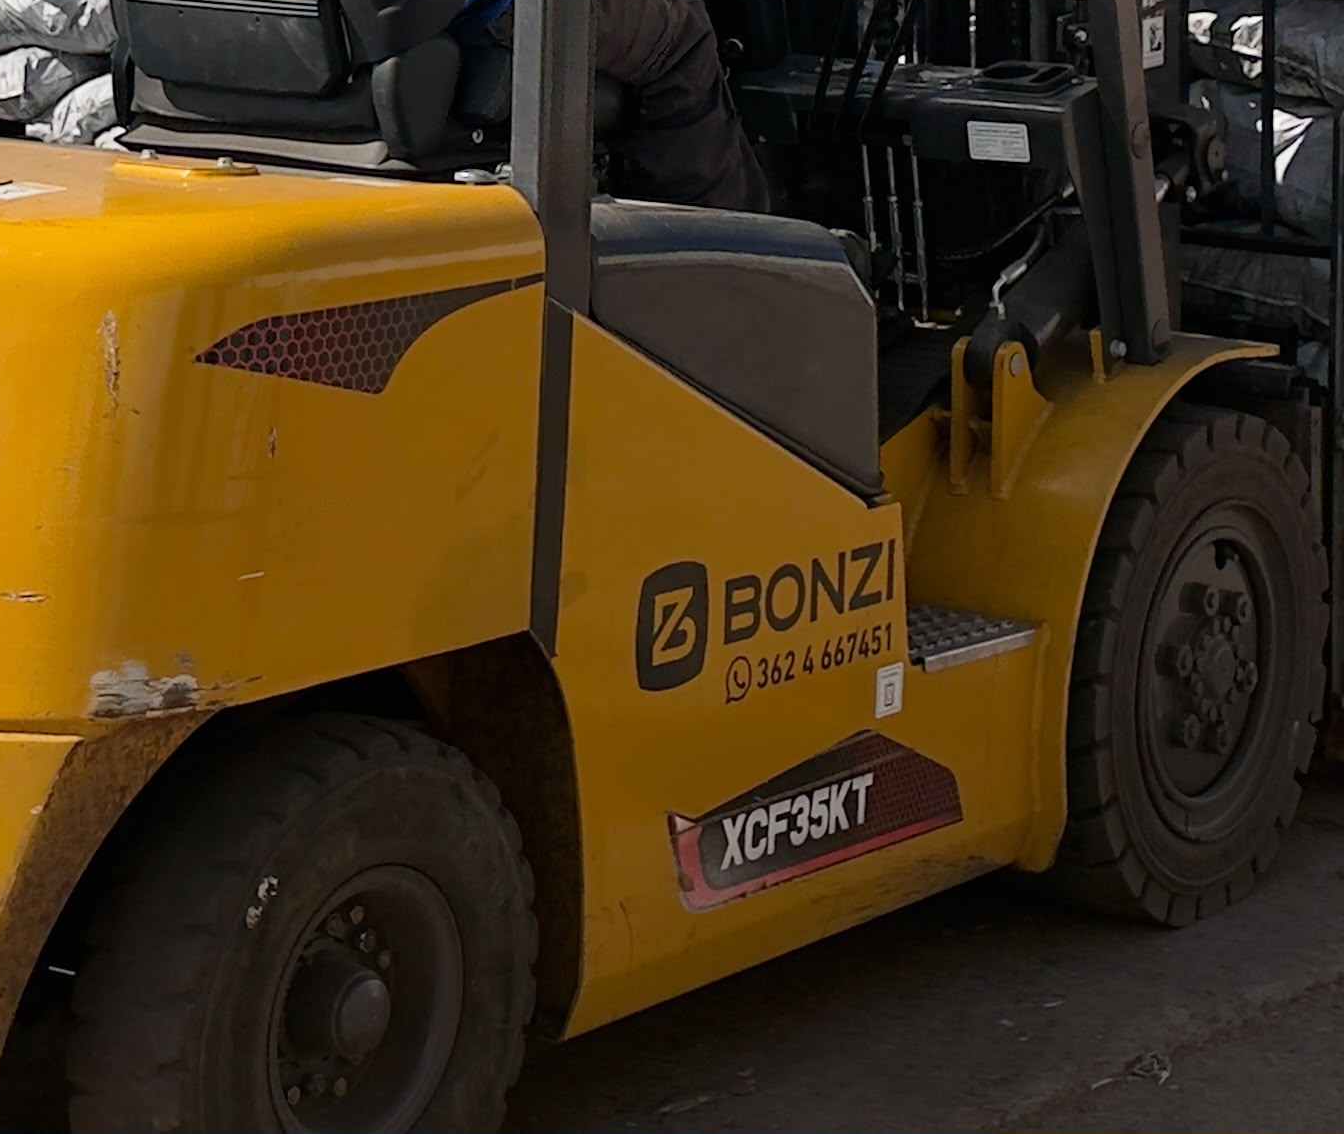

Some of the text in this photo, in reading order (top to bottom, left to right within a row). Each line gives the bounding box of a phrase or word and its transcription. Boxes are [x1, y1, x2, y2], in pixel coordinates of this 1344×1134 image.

[723, 538, 896, 646] BONZI
[757, 622, 892, 689] 362 4 667451
[720, 771, 874, 871] XCF35KT
